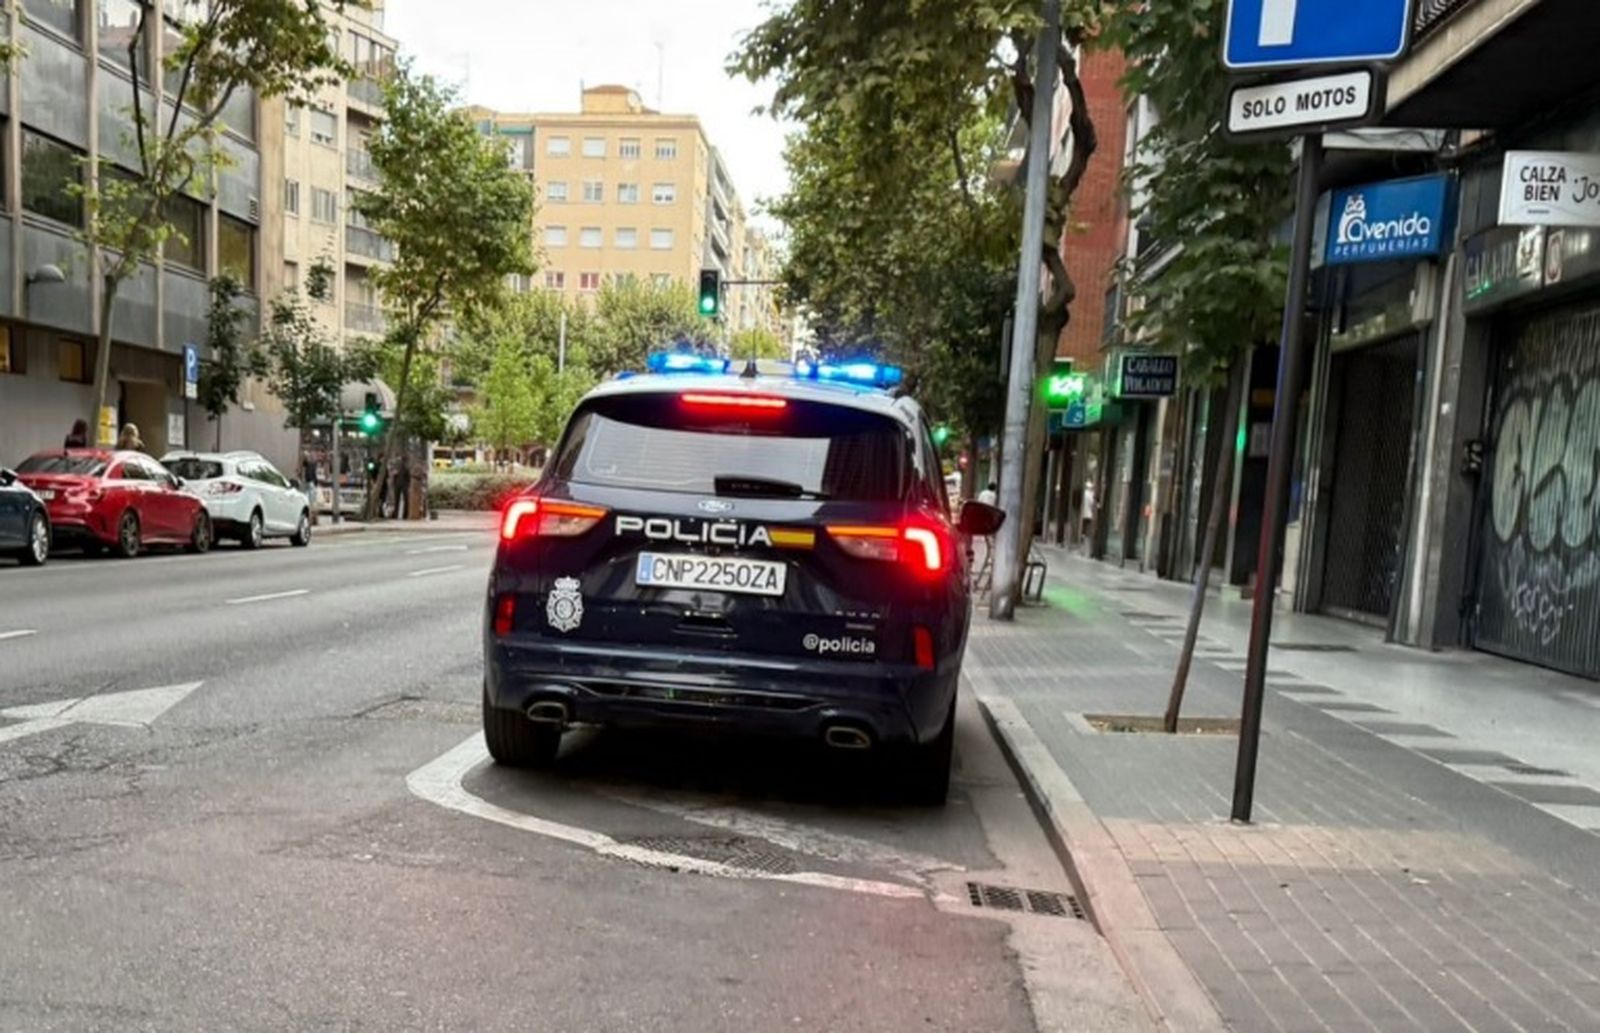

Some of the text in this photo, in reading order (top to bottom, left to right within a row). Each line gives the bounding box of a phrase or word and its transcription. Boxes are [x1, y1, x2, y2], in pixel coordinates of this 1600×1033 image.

[1242, 86, 1356, 119] SOLO MOTOS
[1520, 166, 1566, 183] CALZA
[1524, 185, 1560, 201] BIEN
[615, 515, 773, 547] POLICIA
[803, 633, 876, 654] @policia
